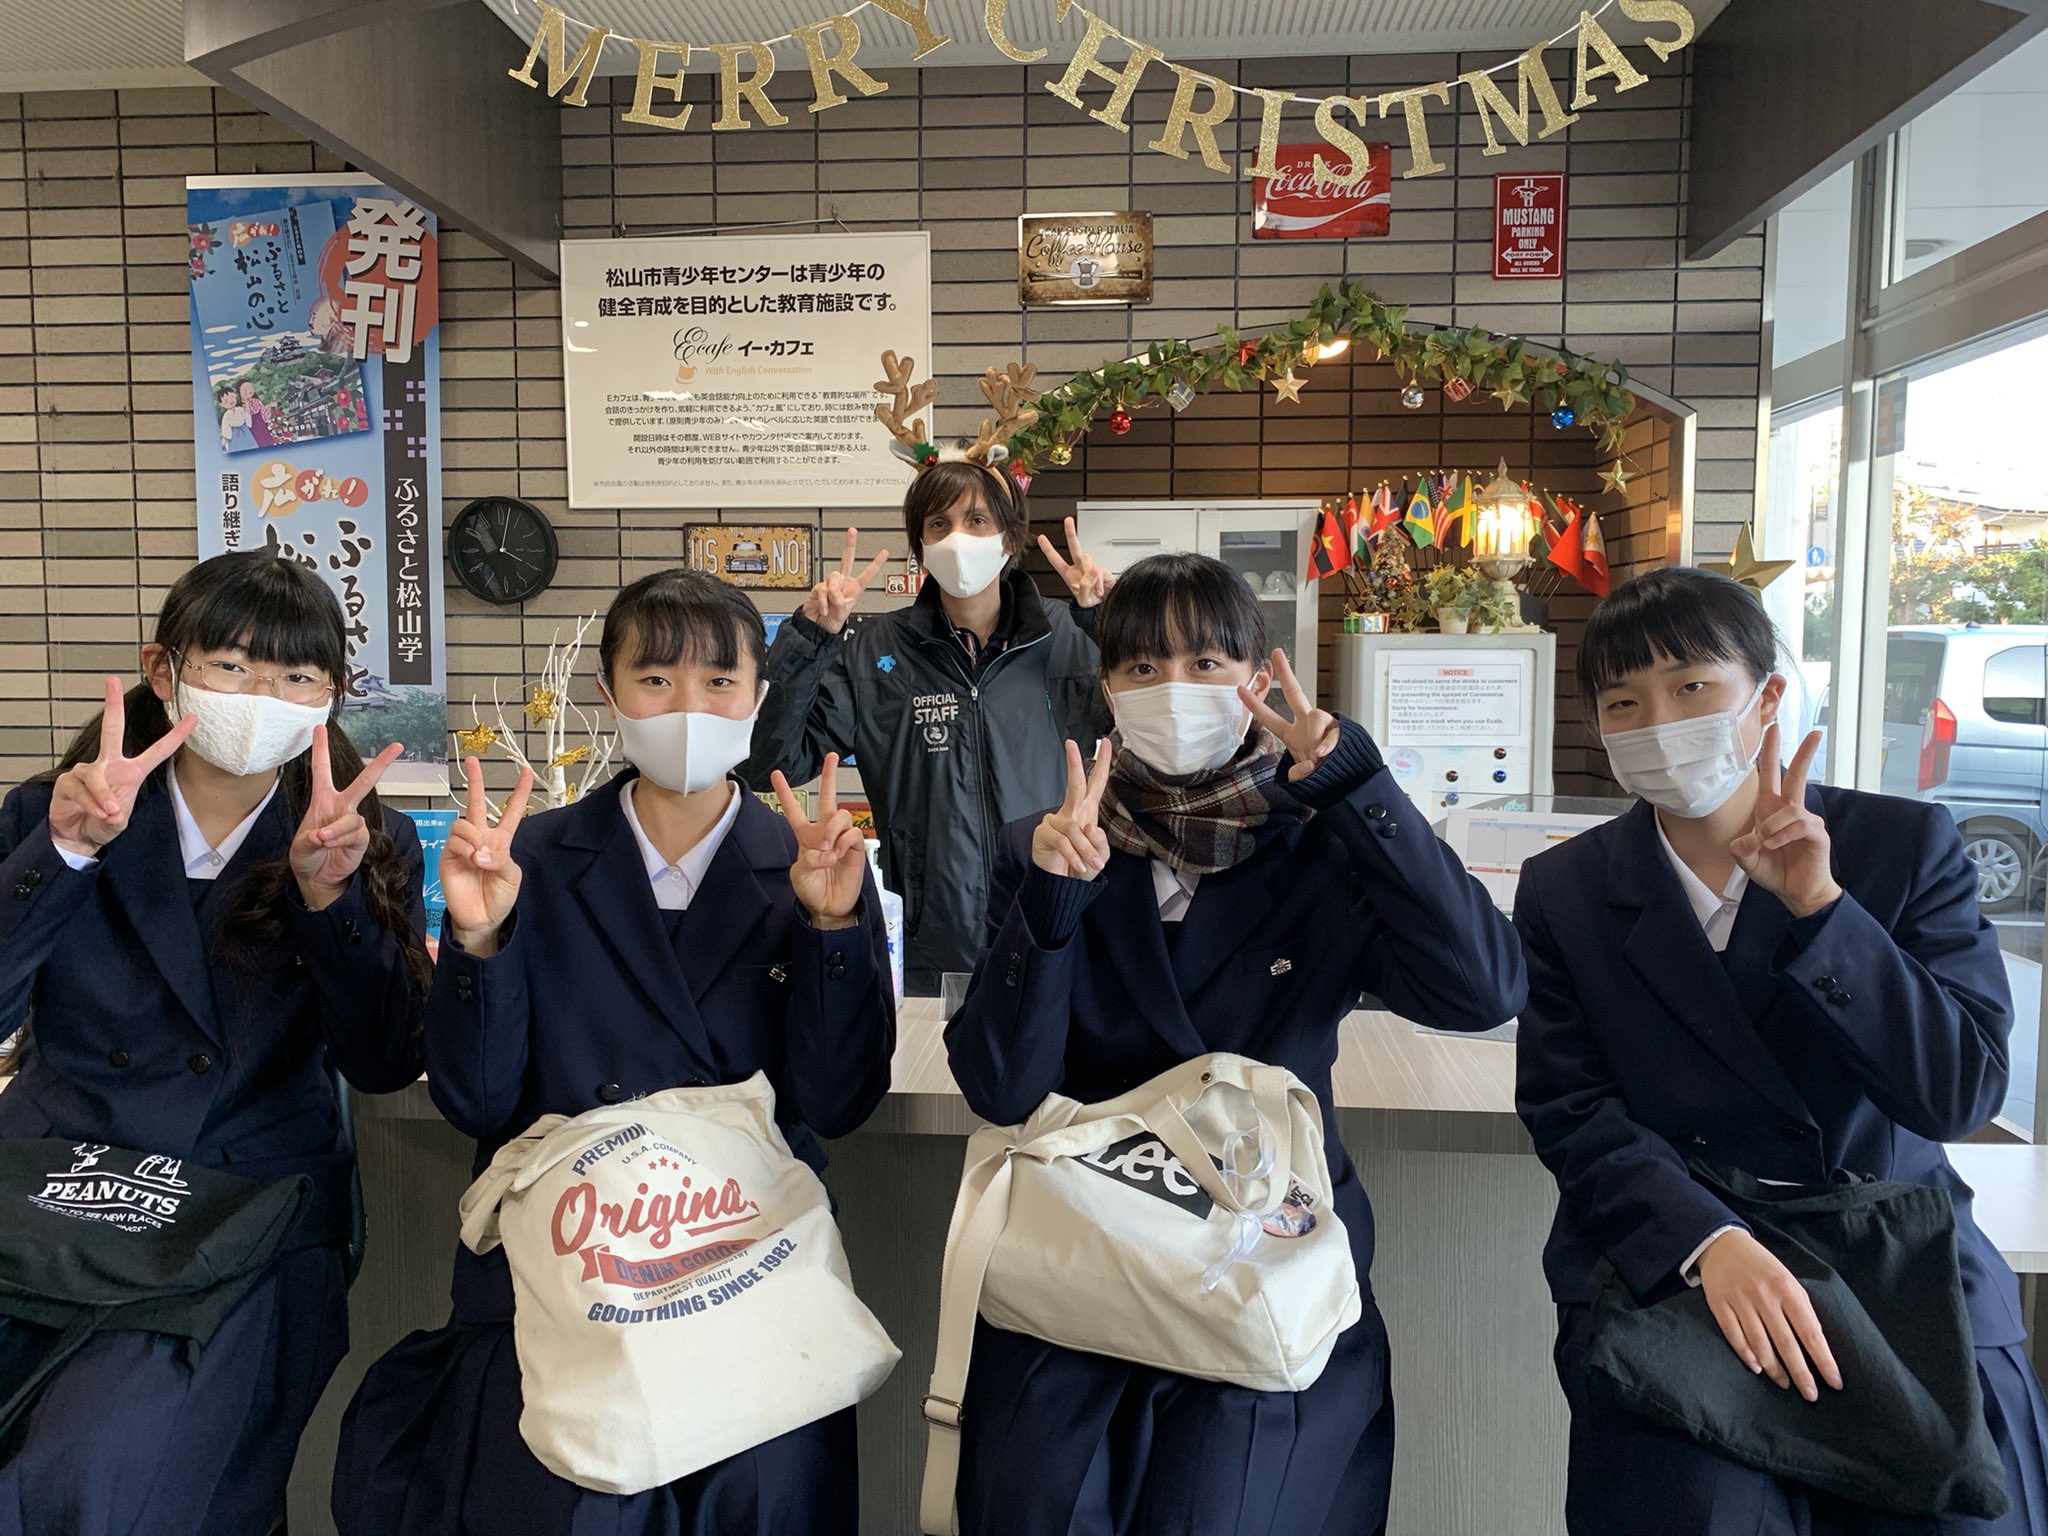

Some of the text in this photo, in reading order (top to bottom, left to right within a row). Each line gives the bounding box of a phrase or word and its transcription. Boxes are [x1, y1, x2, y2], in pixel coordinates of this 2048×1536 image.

[507, 0, 1697, 182] MERRY CHRISTMAS
[1503, 208, 1554, 225] MUSTANG
[1040, 226, 1064, 237] RAN
[1511, 227, 1545, 237] PARKING
[1518, 239, 1537, 249] ONLY
[1026, 233, 1145, 267] Coffee House
[234, 248, 275, 331] 松山の心
[264, 241, 289, 313] ふるさと
[341, 197, 425, 364] 発刊
[605, 262, 885, 288] 松山市青少年センターは青少年の
[598, 292, 897, 318] 健全育成を目的とした教育施設です。
[738, 340, 814, 357] イー・カフェ
[705, 365, 813, 376] With English Conversation
[394, 477, 424, 663] ふるさと松山学
[691, 538, 719, 576] US
[890, 583, 904, 592] 66
[328, 520, 372, 698] ふるさと
[912, 693, 958, 708] OFFICIAL
[914, 705, 959, 725] STAFF
[621, 1142, 698, 1166] U.S.A. COMPANY
[1081, 1140, 1198, 1196] Lee
[38, 1180, 180, 1216] PEANUTS
[102, 1212, 127, 1222] NEW
[127, 1213, 163, 1230] PLACES
[551, 1176, 758, 1256] Origina
[587, 1237, 798, 1324] GOODTHING SINCE 1982
[615, 1257, 677, 1286] DENIM
[663, 1267, 733, 1301] FINEST QUALITY
